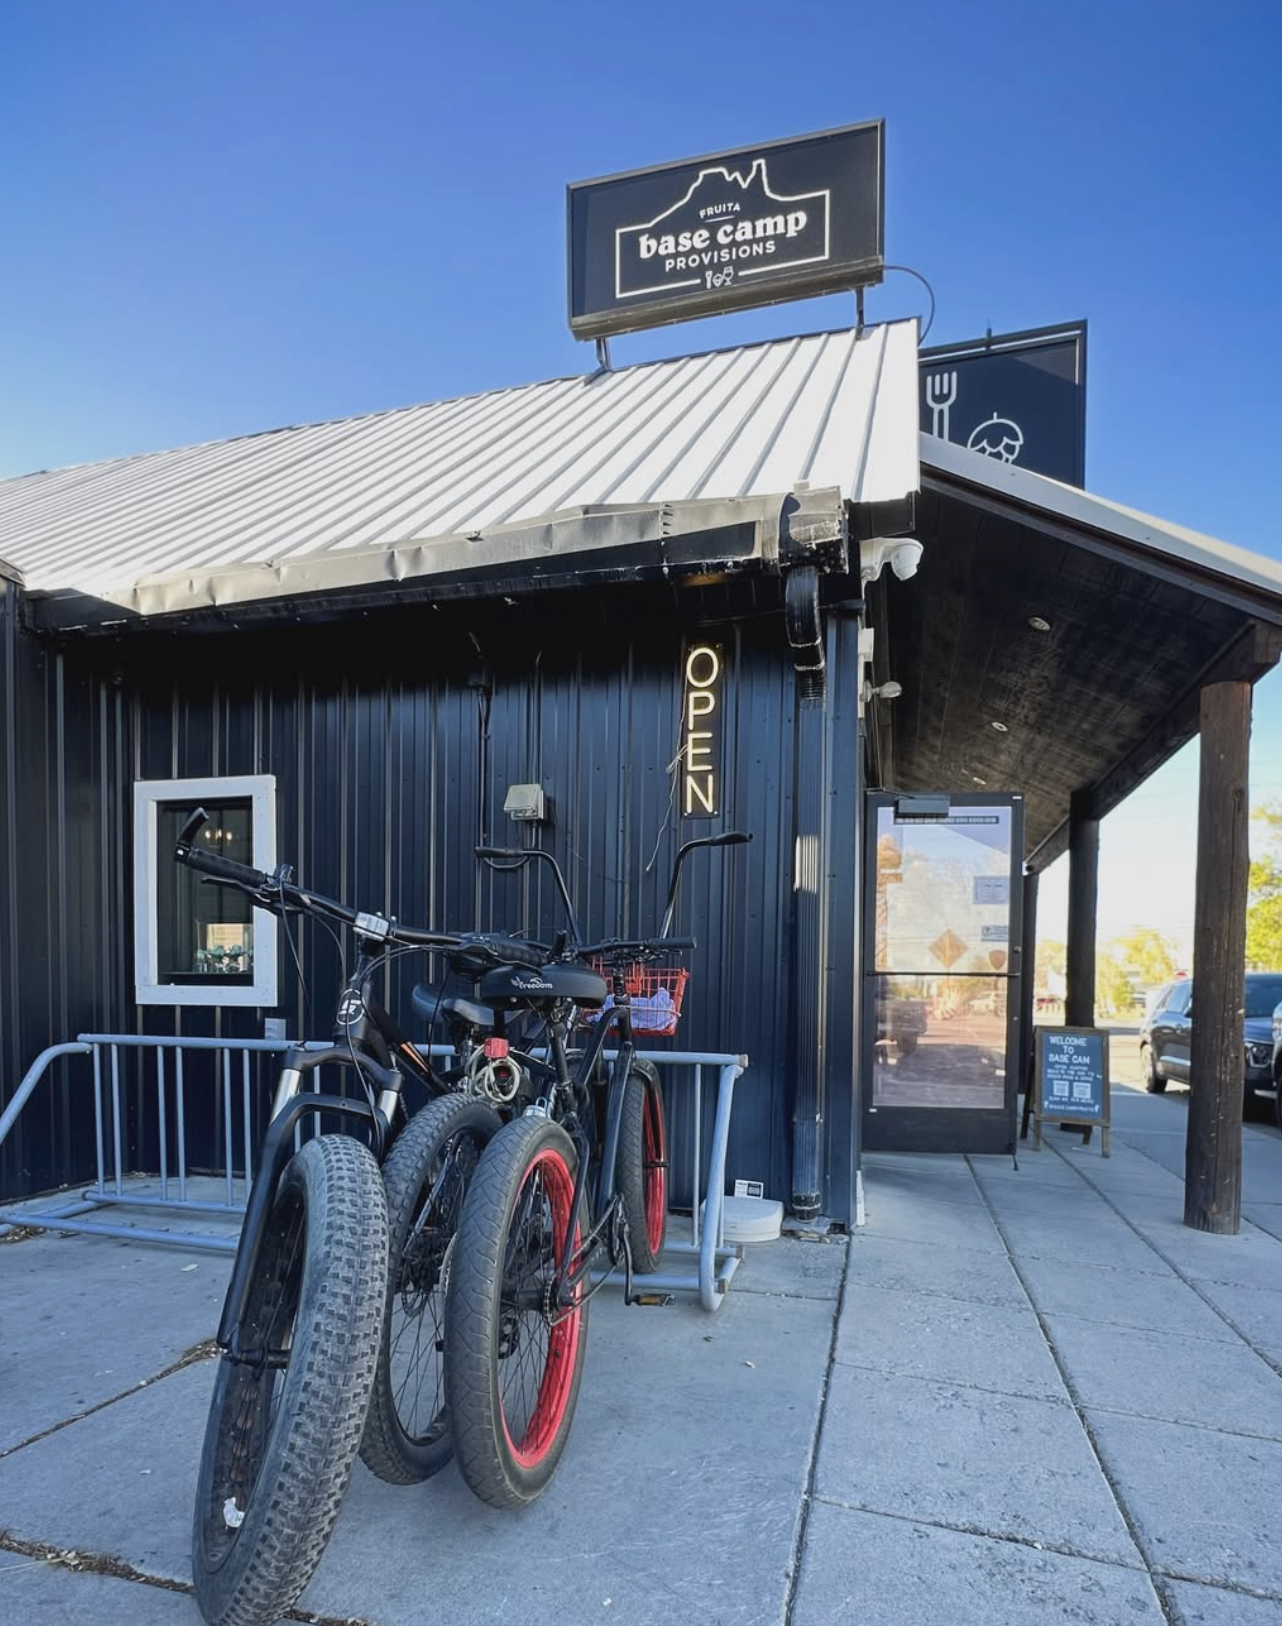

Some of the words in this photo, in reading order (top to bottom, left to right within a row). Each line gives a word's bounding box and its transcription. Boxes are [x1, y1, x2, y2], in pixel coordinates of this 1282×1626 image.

[699, 202, 741, 219] FRUITA
[639, 228, 711, 260] base
[716, 210, 808, 245] camp
[665, 240, 776, 273] PROVISIONS
[686, 647, 719, 814] OPEN
[1049, 1036, 1087, 1046] WELCOME
[1049, 1053, 1069, 1063] BASE
[1063, 1046, 1075, 1054] TO
